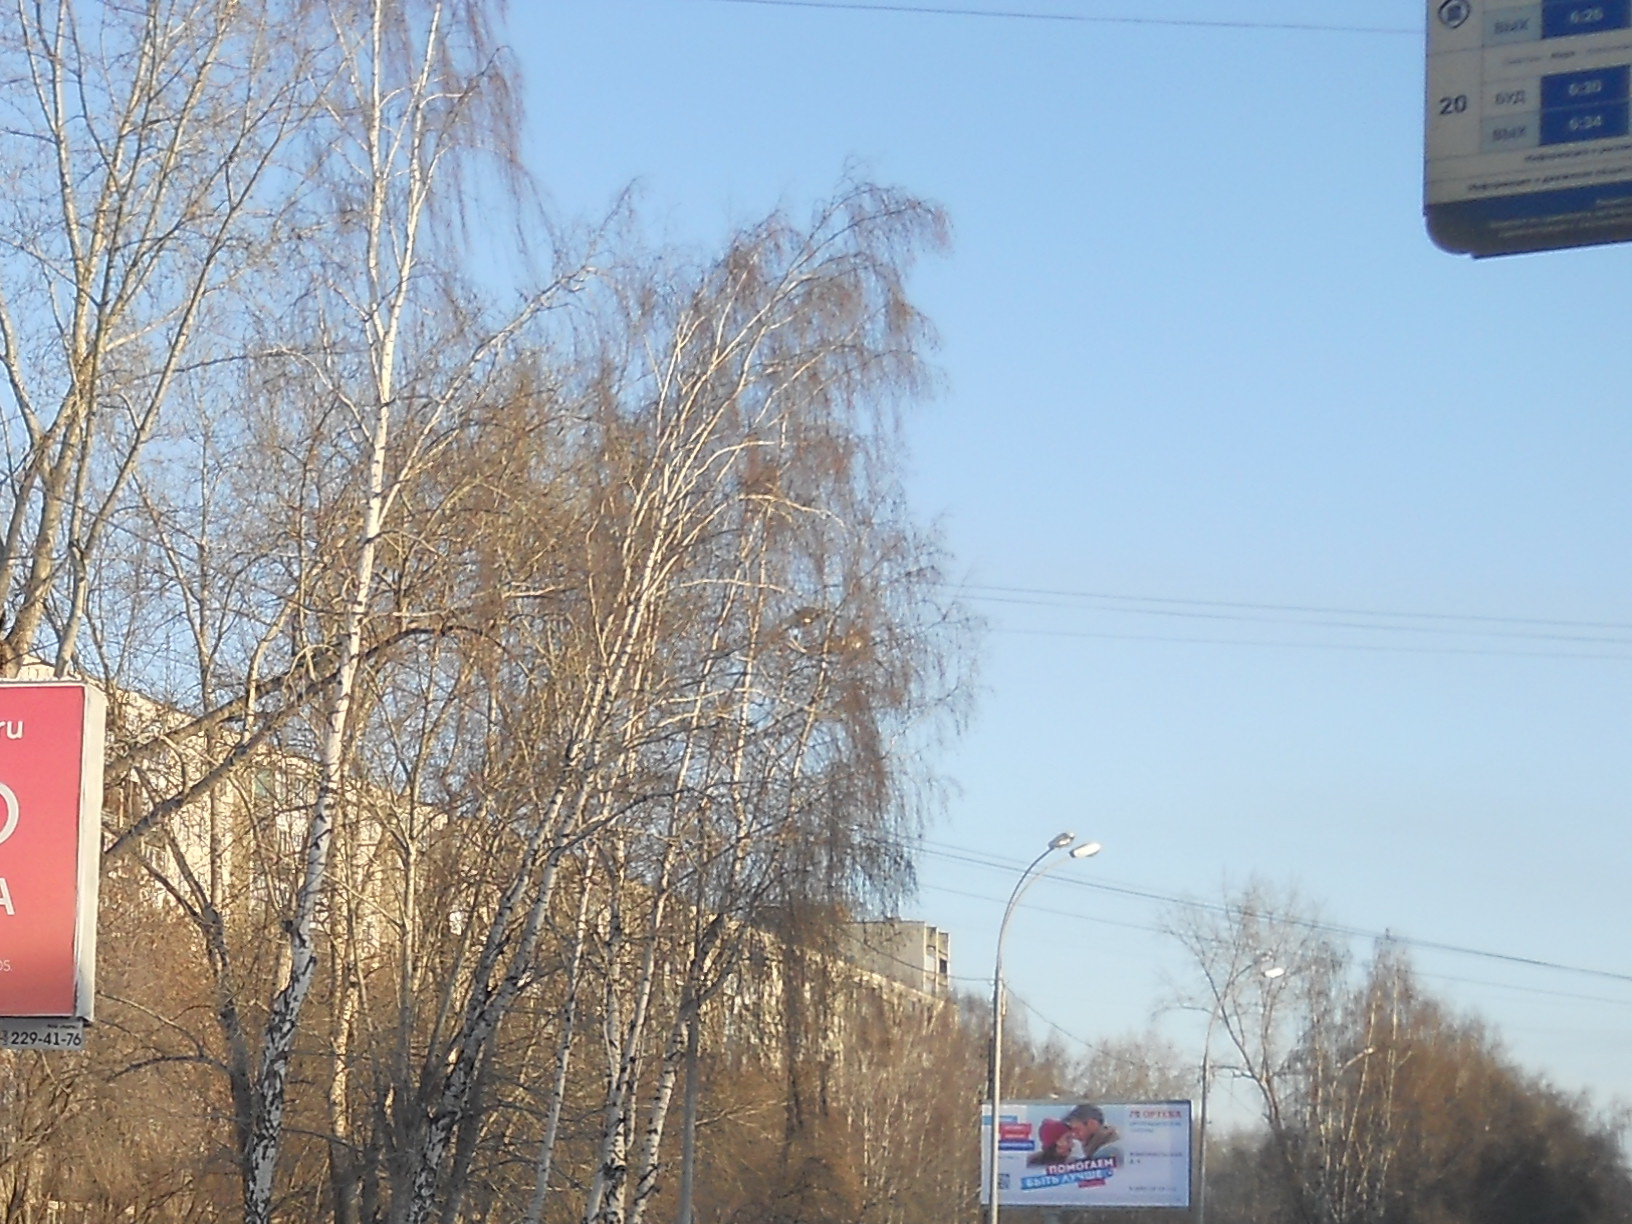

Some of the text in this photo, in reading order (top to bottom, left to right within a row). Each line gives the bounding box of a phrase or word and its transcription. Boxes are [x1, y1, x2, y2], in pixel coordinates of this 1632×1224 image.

[1439, 95, 1467, 115] 20
[11, 1031, 82, 1046] 229-41-76
[1048, 1158, 1114, 1174] ПОМОГАЕМ
[1026, 1176, 1060, 1187] БЫТЬ
